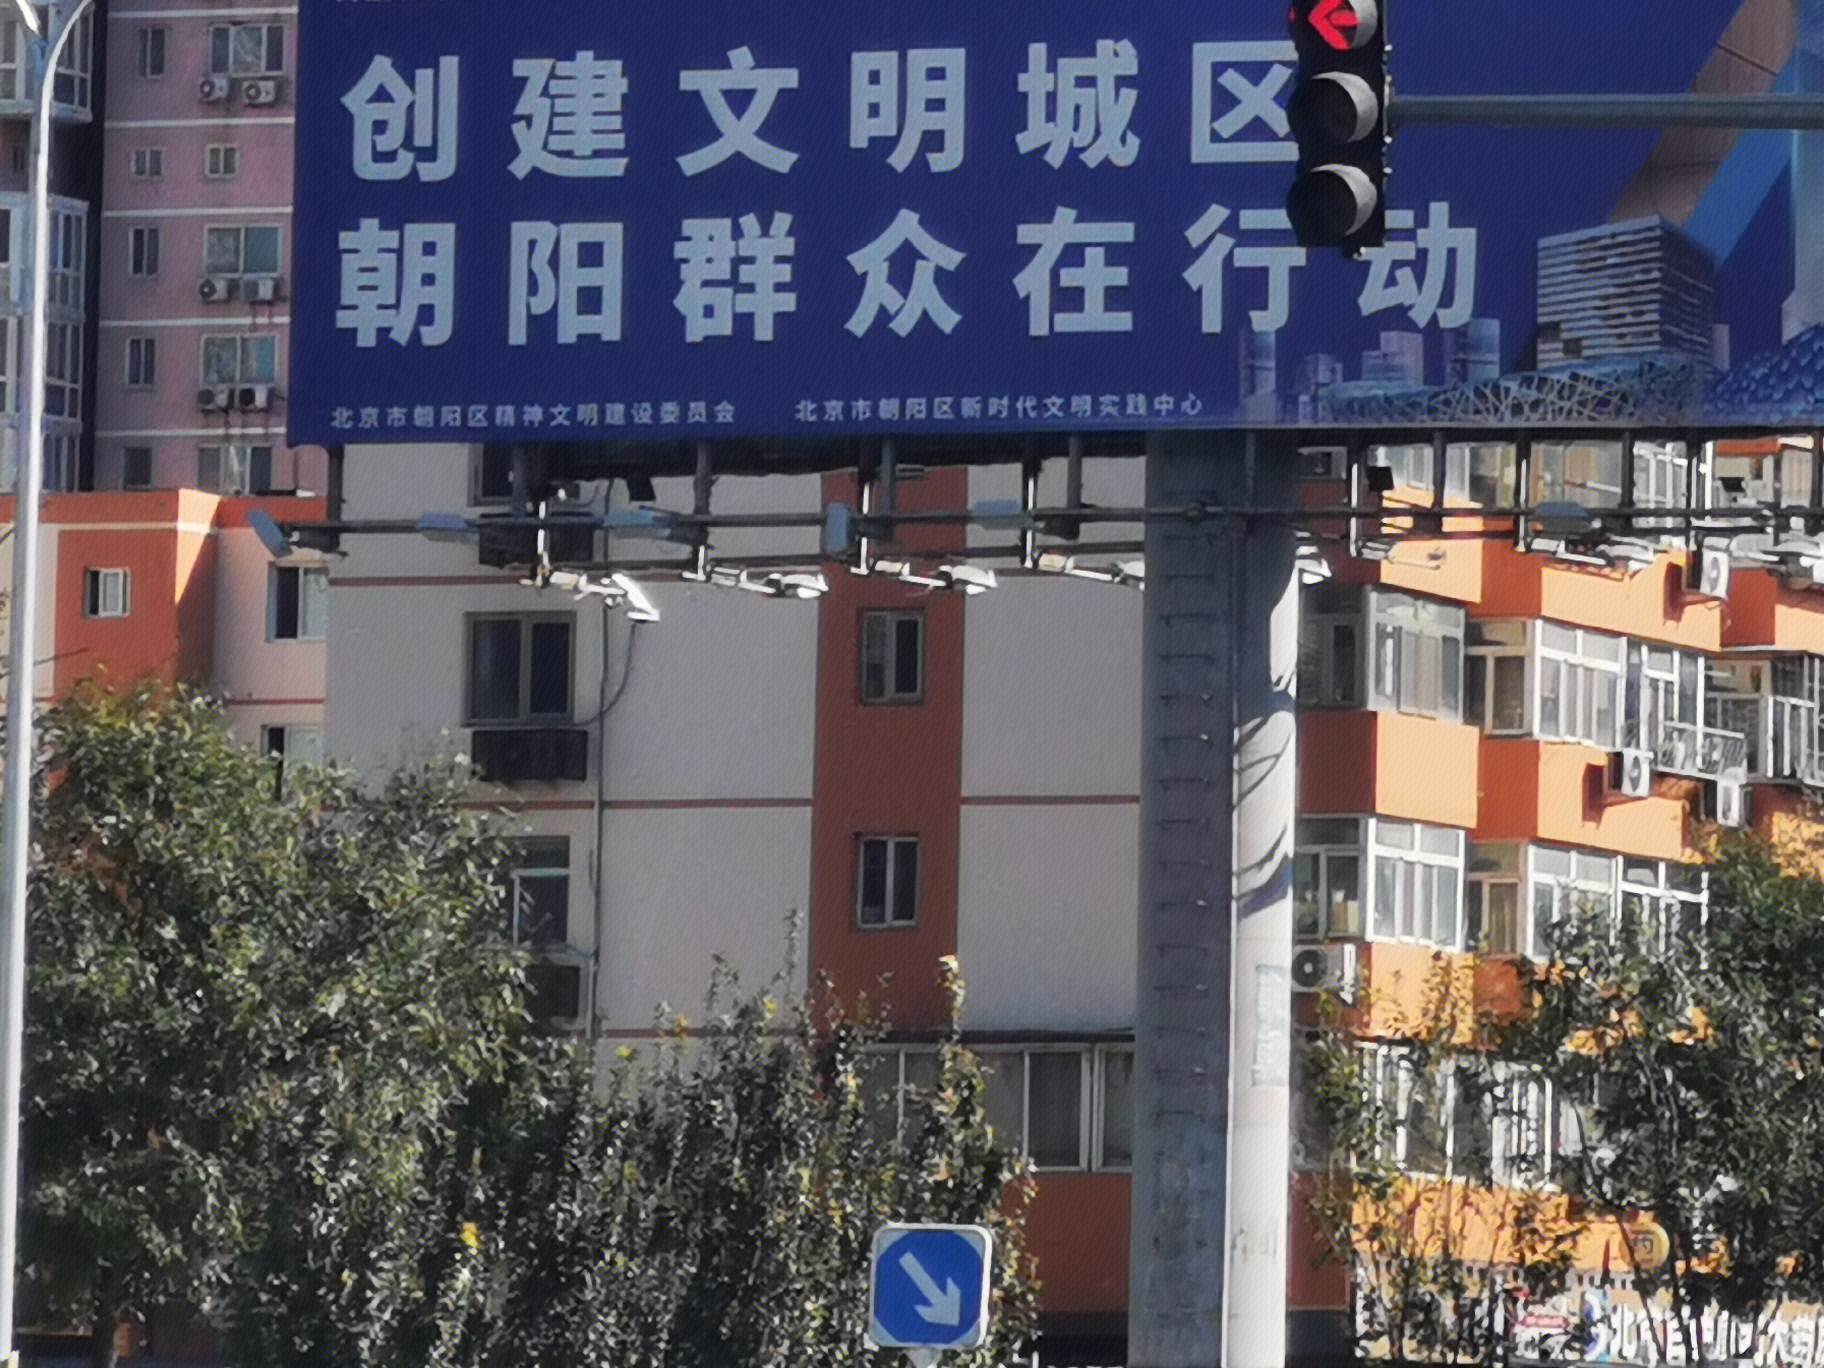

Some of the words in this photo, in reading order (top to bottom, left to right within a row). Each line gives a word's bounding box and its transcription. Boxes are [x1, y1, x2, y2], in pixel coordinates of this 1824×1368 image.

[341, 40, 1298, 183] 创建文明城区
[336, 201, 1477, 347] 朝阳群众在行动
[331, 401, 736, 429] 北京市朝阳区精神文明建设委员会
[795, 393, 1202, 422] 北京市朝阳区新时代文明实践中心
